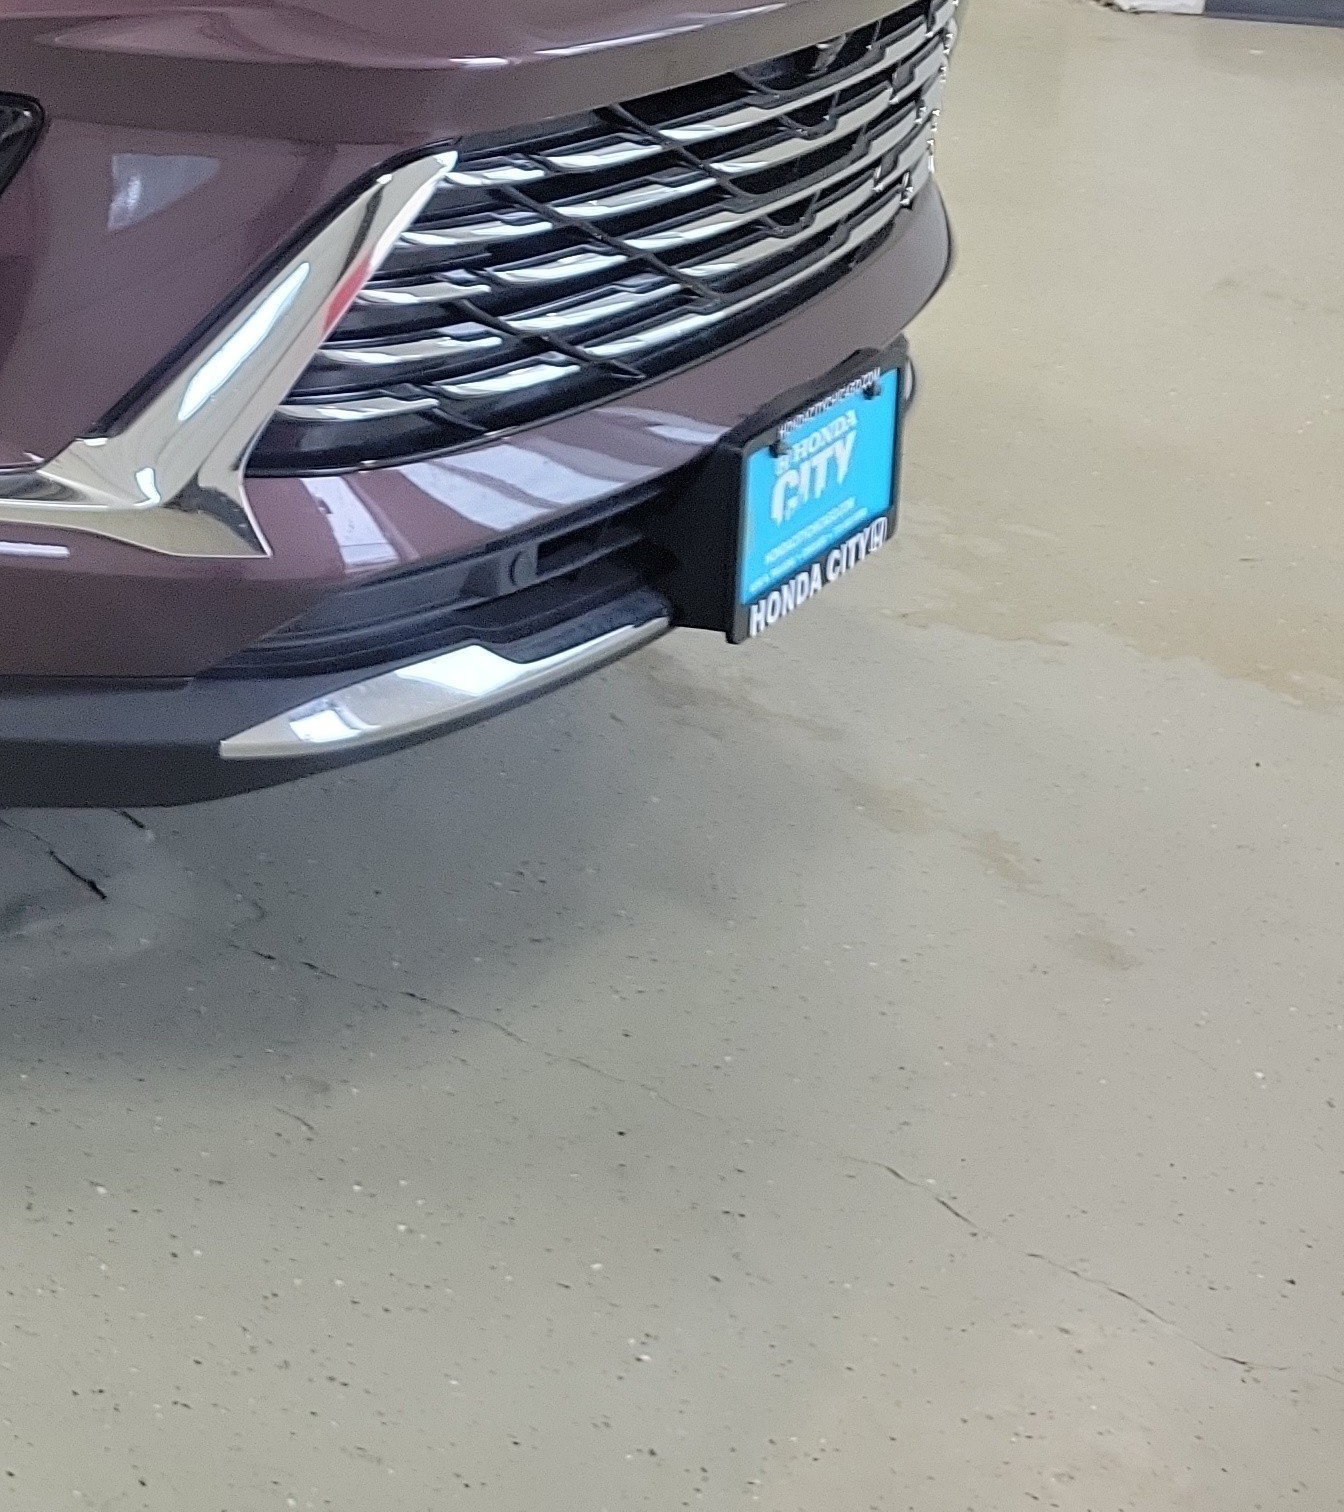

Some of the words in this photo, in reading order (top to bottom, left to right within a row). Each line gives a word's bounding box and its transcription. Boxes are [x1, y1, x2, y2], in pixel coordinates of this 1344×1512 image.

[771, 429, 858, 526] CITY
[750, 563, 823, 638] HONDA
[826, 527, 871, 582] CITY
